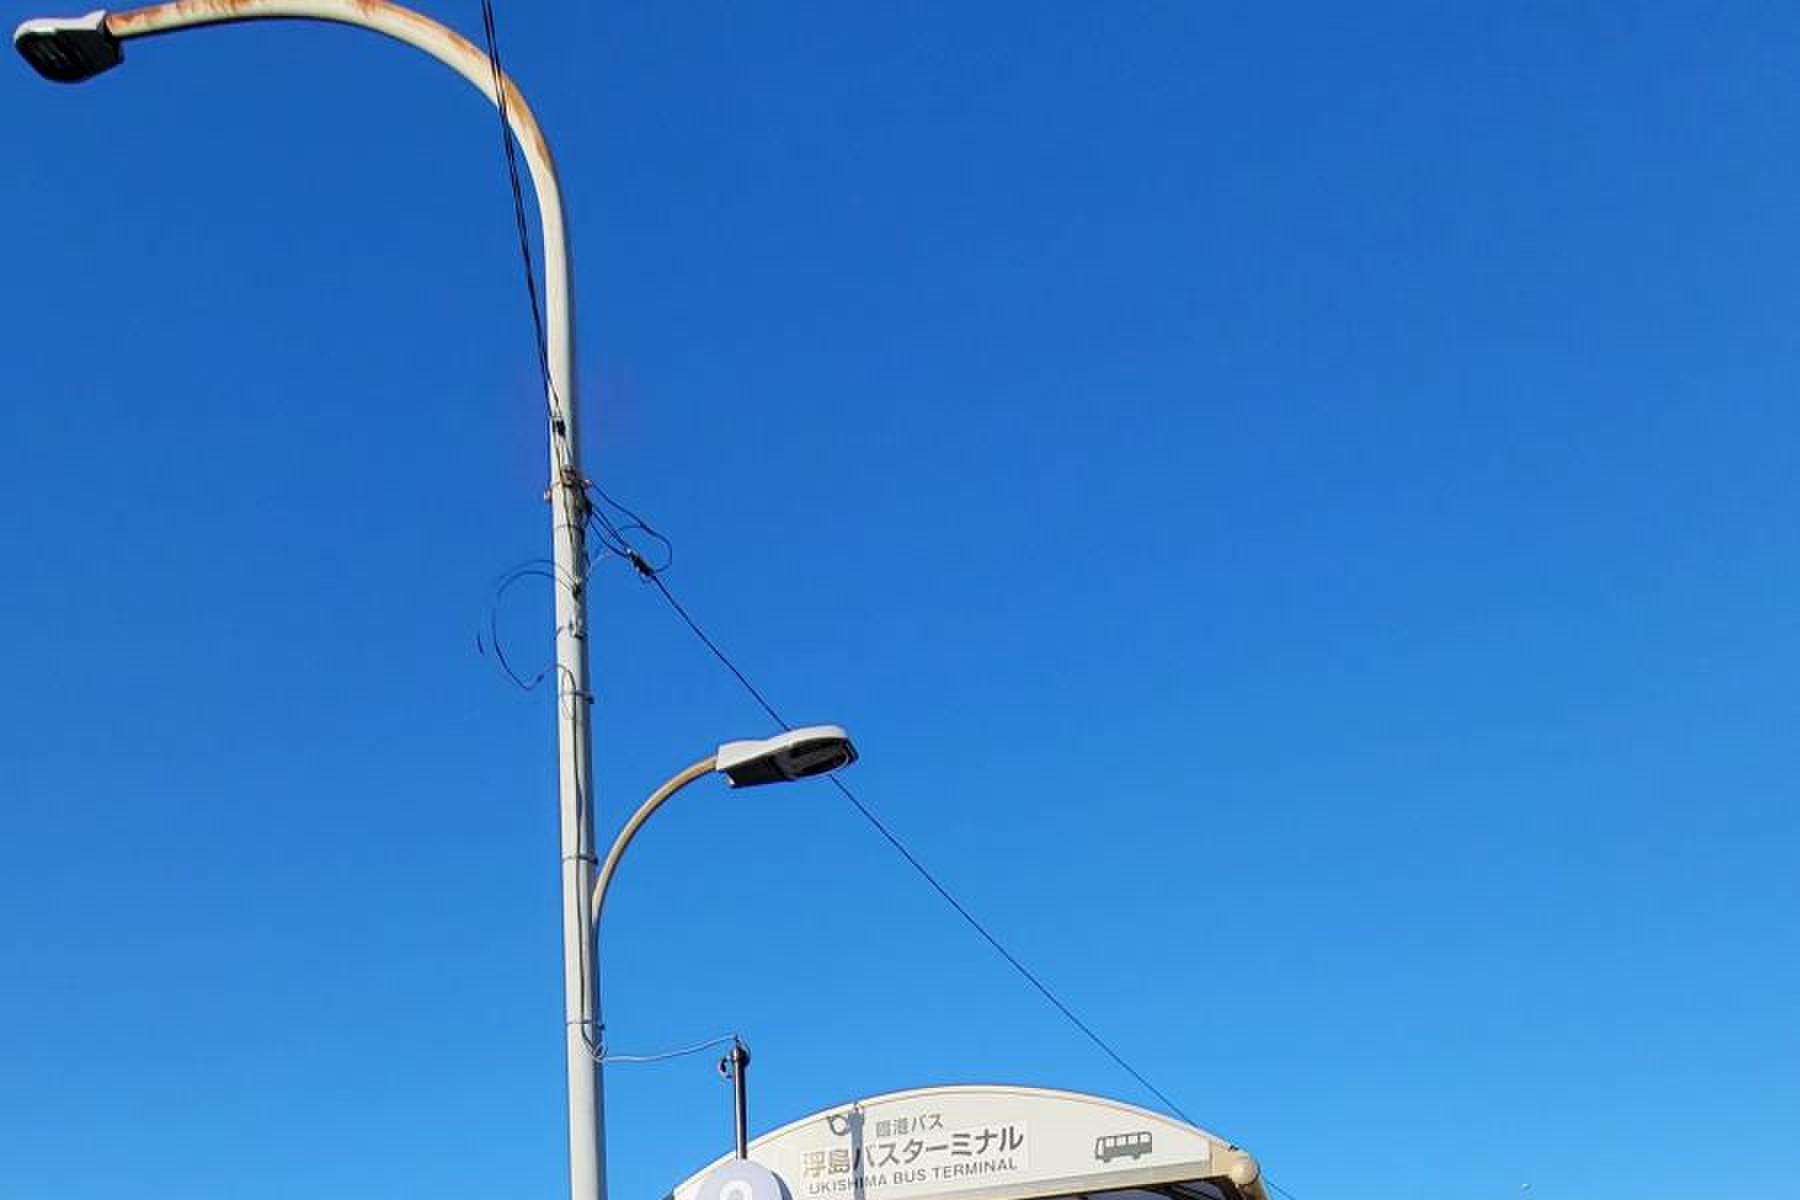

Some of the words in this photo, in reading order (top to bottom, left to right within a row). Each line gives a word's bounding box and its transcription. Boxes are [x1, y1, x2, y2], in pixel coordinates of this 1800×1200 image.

[803, 1125, 1024, 1179] 浮島バスターミナル
[809, 1175, 888, 1195] UKISHIMA
[893, 1168, 927, 1185] BUS
[931, 1157, 1018, 1180] TERMINAL
